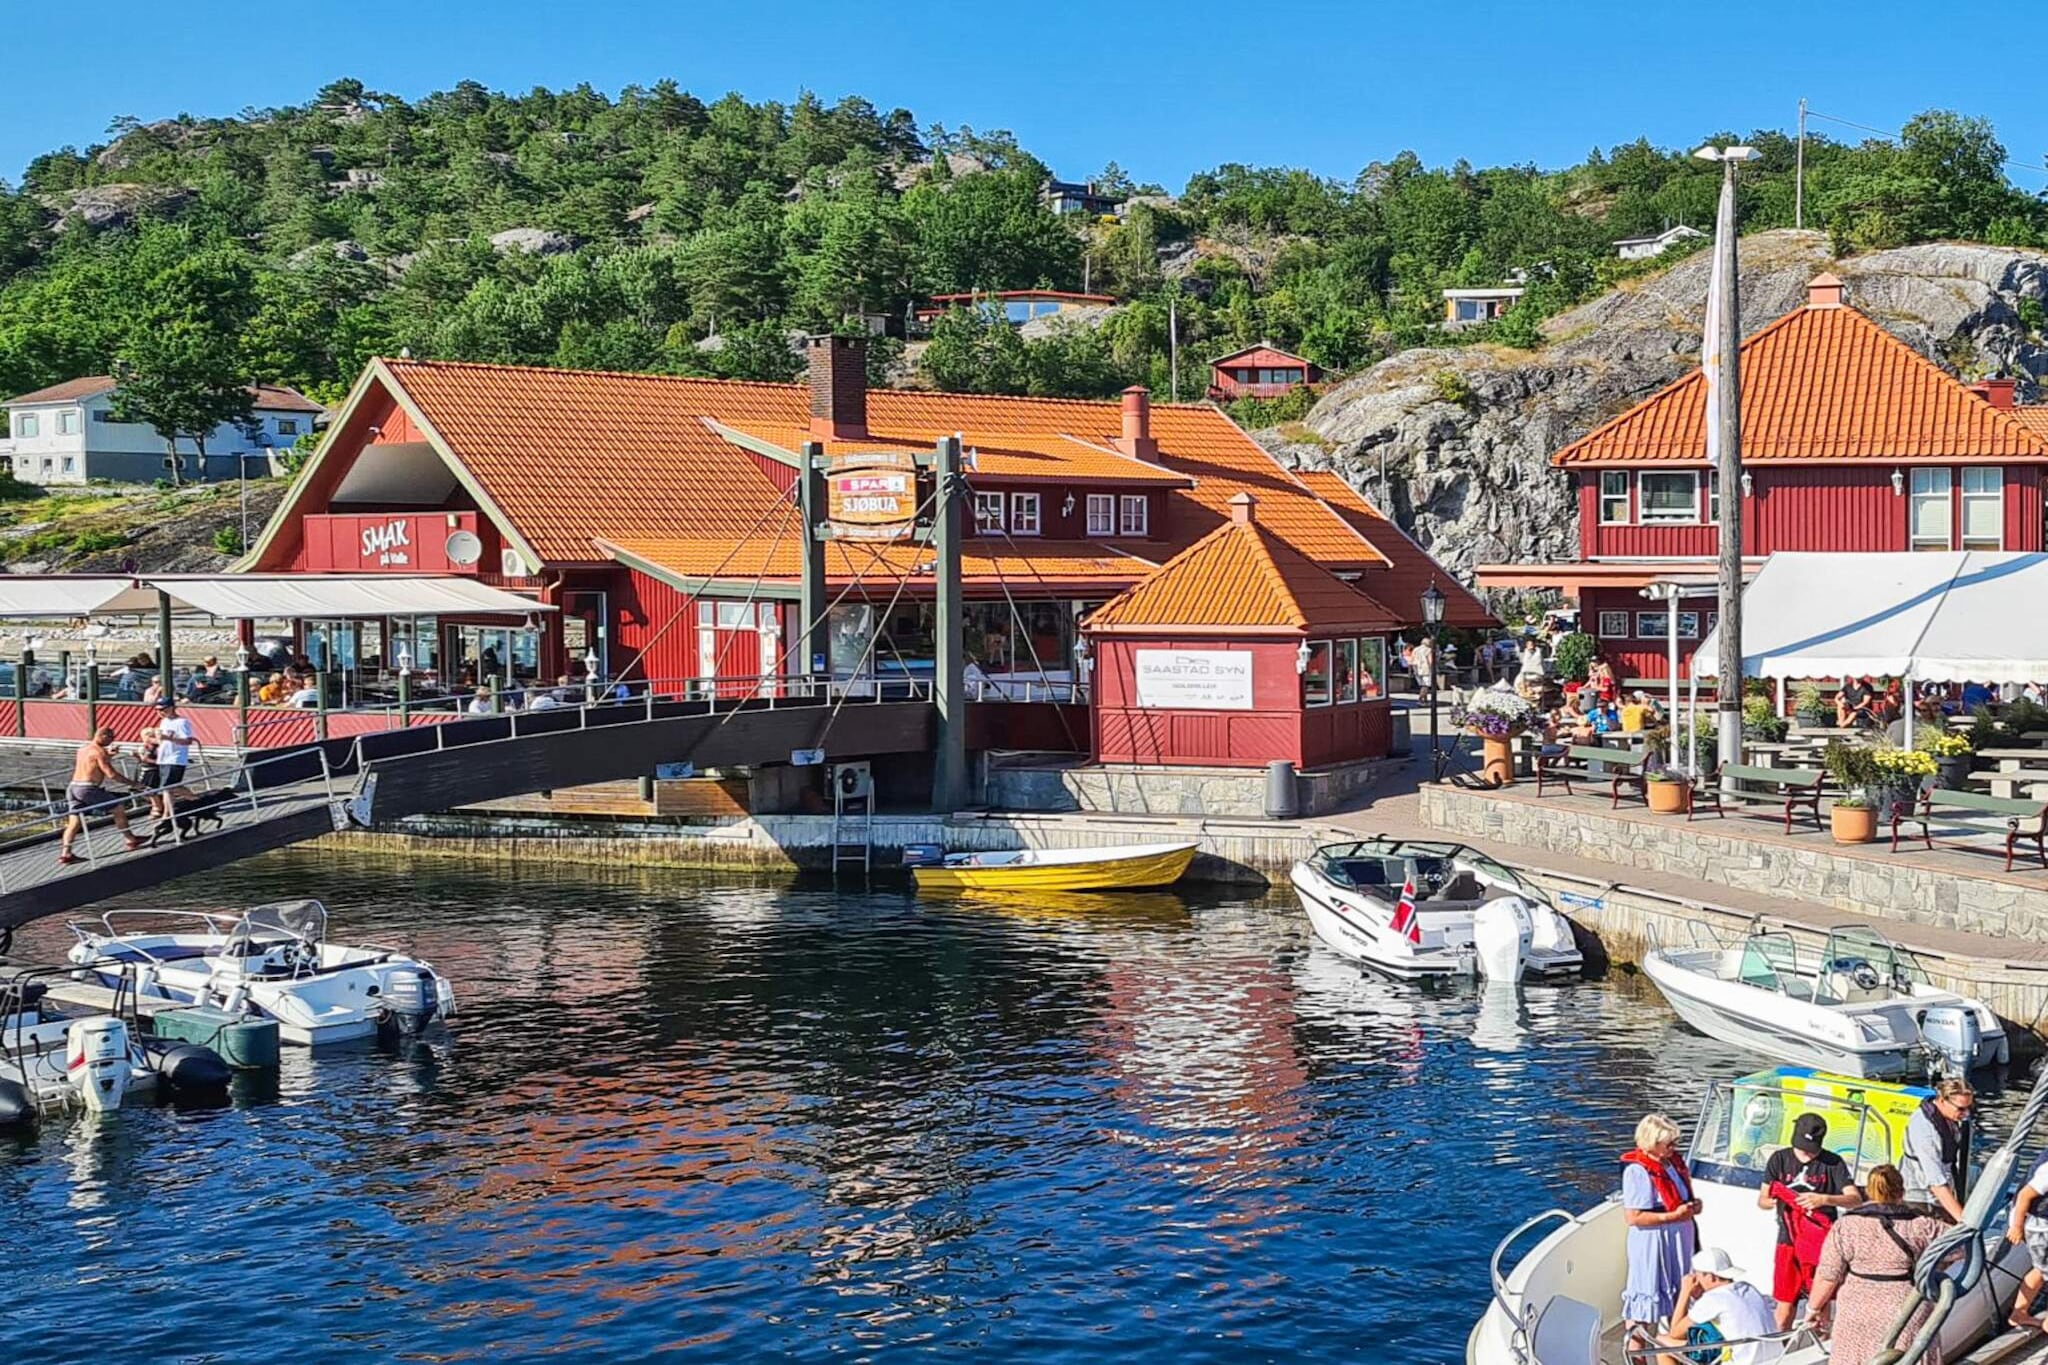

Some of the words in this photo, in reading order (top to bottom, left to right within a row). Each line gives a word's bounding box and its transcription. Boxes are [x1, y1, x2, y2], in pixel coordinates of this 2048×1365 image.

[849, 478, 888, 491] SPAR
[843, 496, 899, 513] SJØBUA
[361, 519, 410, 556] SMAK
[1143, 664, 1210, 675] SAASTAD
[1214, 665, 1246, 675] SYN
